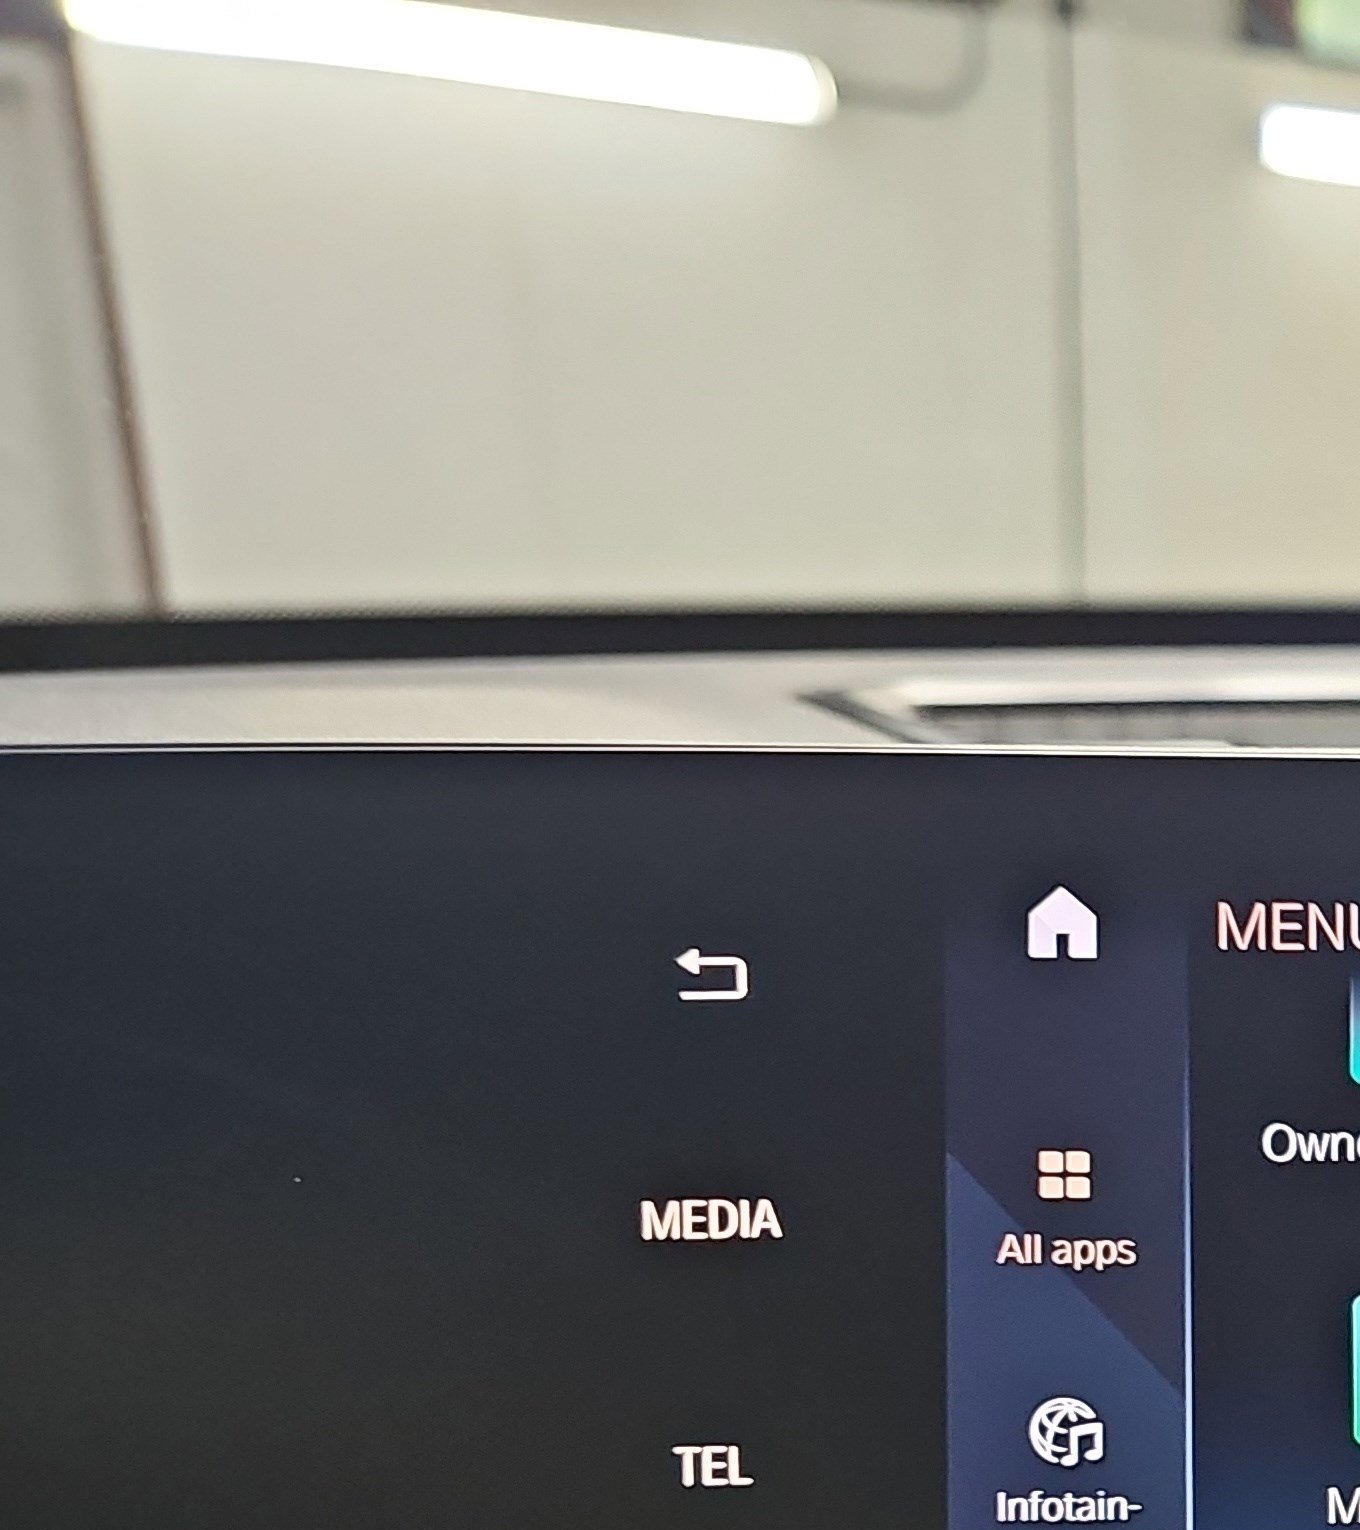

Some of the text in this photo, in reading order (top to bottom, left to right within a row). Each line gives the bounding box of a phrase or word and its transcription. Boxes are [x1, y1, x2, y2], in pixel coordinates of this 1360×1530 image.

[641, 1198, 783, 1241] MEDIA
[996, 1233, 1137, 1271] All apps
[671, 1445, 755, 1487] TEL
[996, 1490, 1143, 1523] Infotain-
